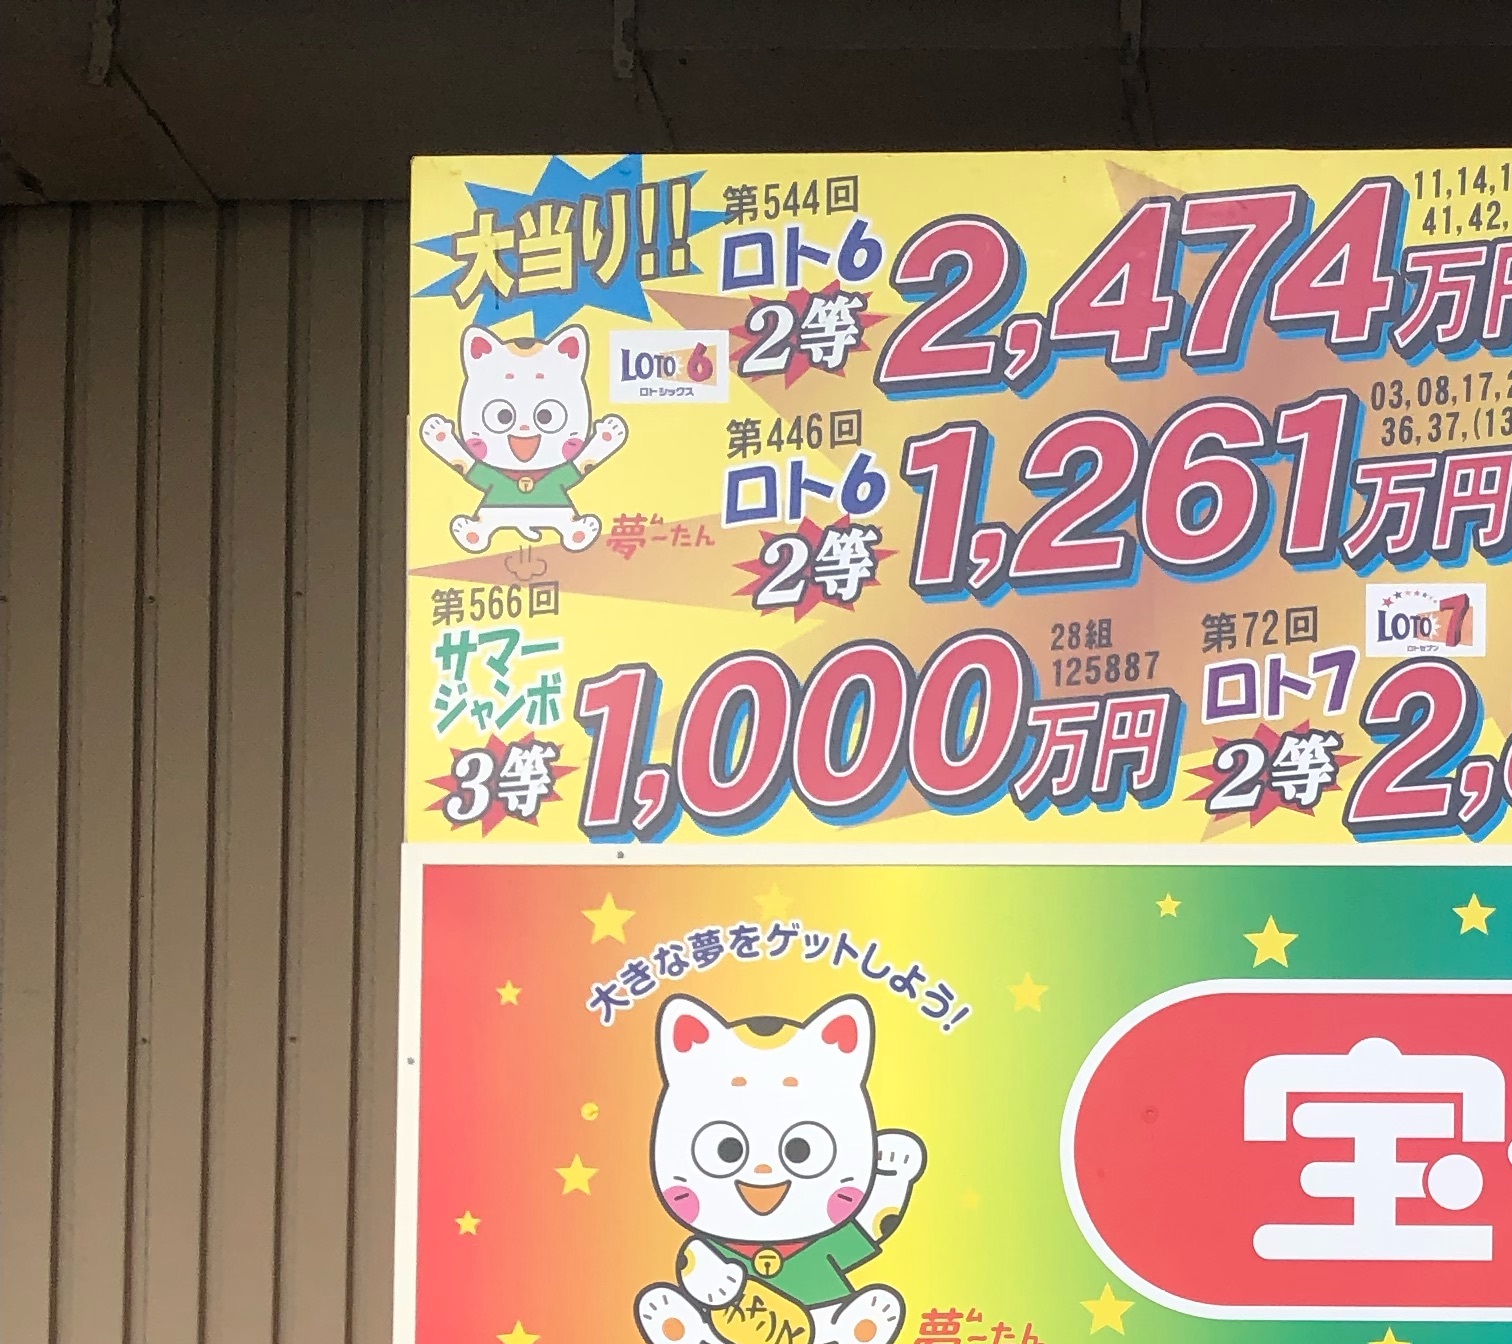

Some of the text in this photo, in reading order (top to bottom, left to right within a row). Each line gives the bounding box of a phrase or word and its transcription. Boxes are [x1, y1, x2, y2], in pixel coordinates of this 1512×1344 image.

[722, 175, 860, 225] 第544回
[452, 180, 690, 308] 大当り!!
[719, 217, 886, 293] ロト6
[621, 342, 714, 382] LOTO 6
[739, 293, 866, 378] 2等
[639, 387, 695, 397] ロトシックス
[726, 409, 863, 459] 第446回
[721, 452, 887, 528] ロト6
[752, 522, 876, 611] 2等
[430, 580, 560, 627] 第566回
[1201, 606, 1319, 654] 第72回
[1377, 594, 1470, 647] LOTO 7
[434, 627, 562, 680] サマー
[1050, 619, 1114, 652] 28組
[1050, 652, 1160, 688] 125887
[1202, 647, 1360, 722] ロト7
[434, 679, 564, 735] ジャンボ
[579, 631, 1174, 836] 1,000万円
[449, 745, 557, 821] 3等
[1208, 731, 1340, 814] 2等
[586, 922, 972, 1033] 大きな夢をゲットしよう!
